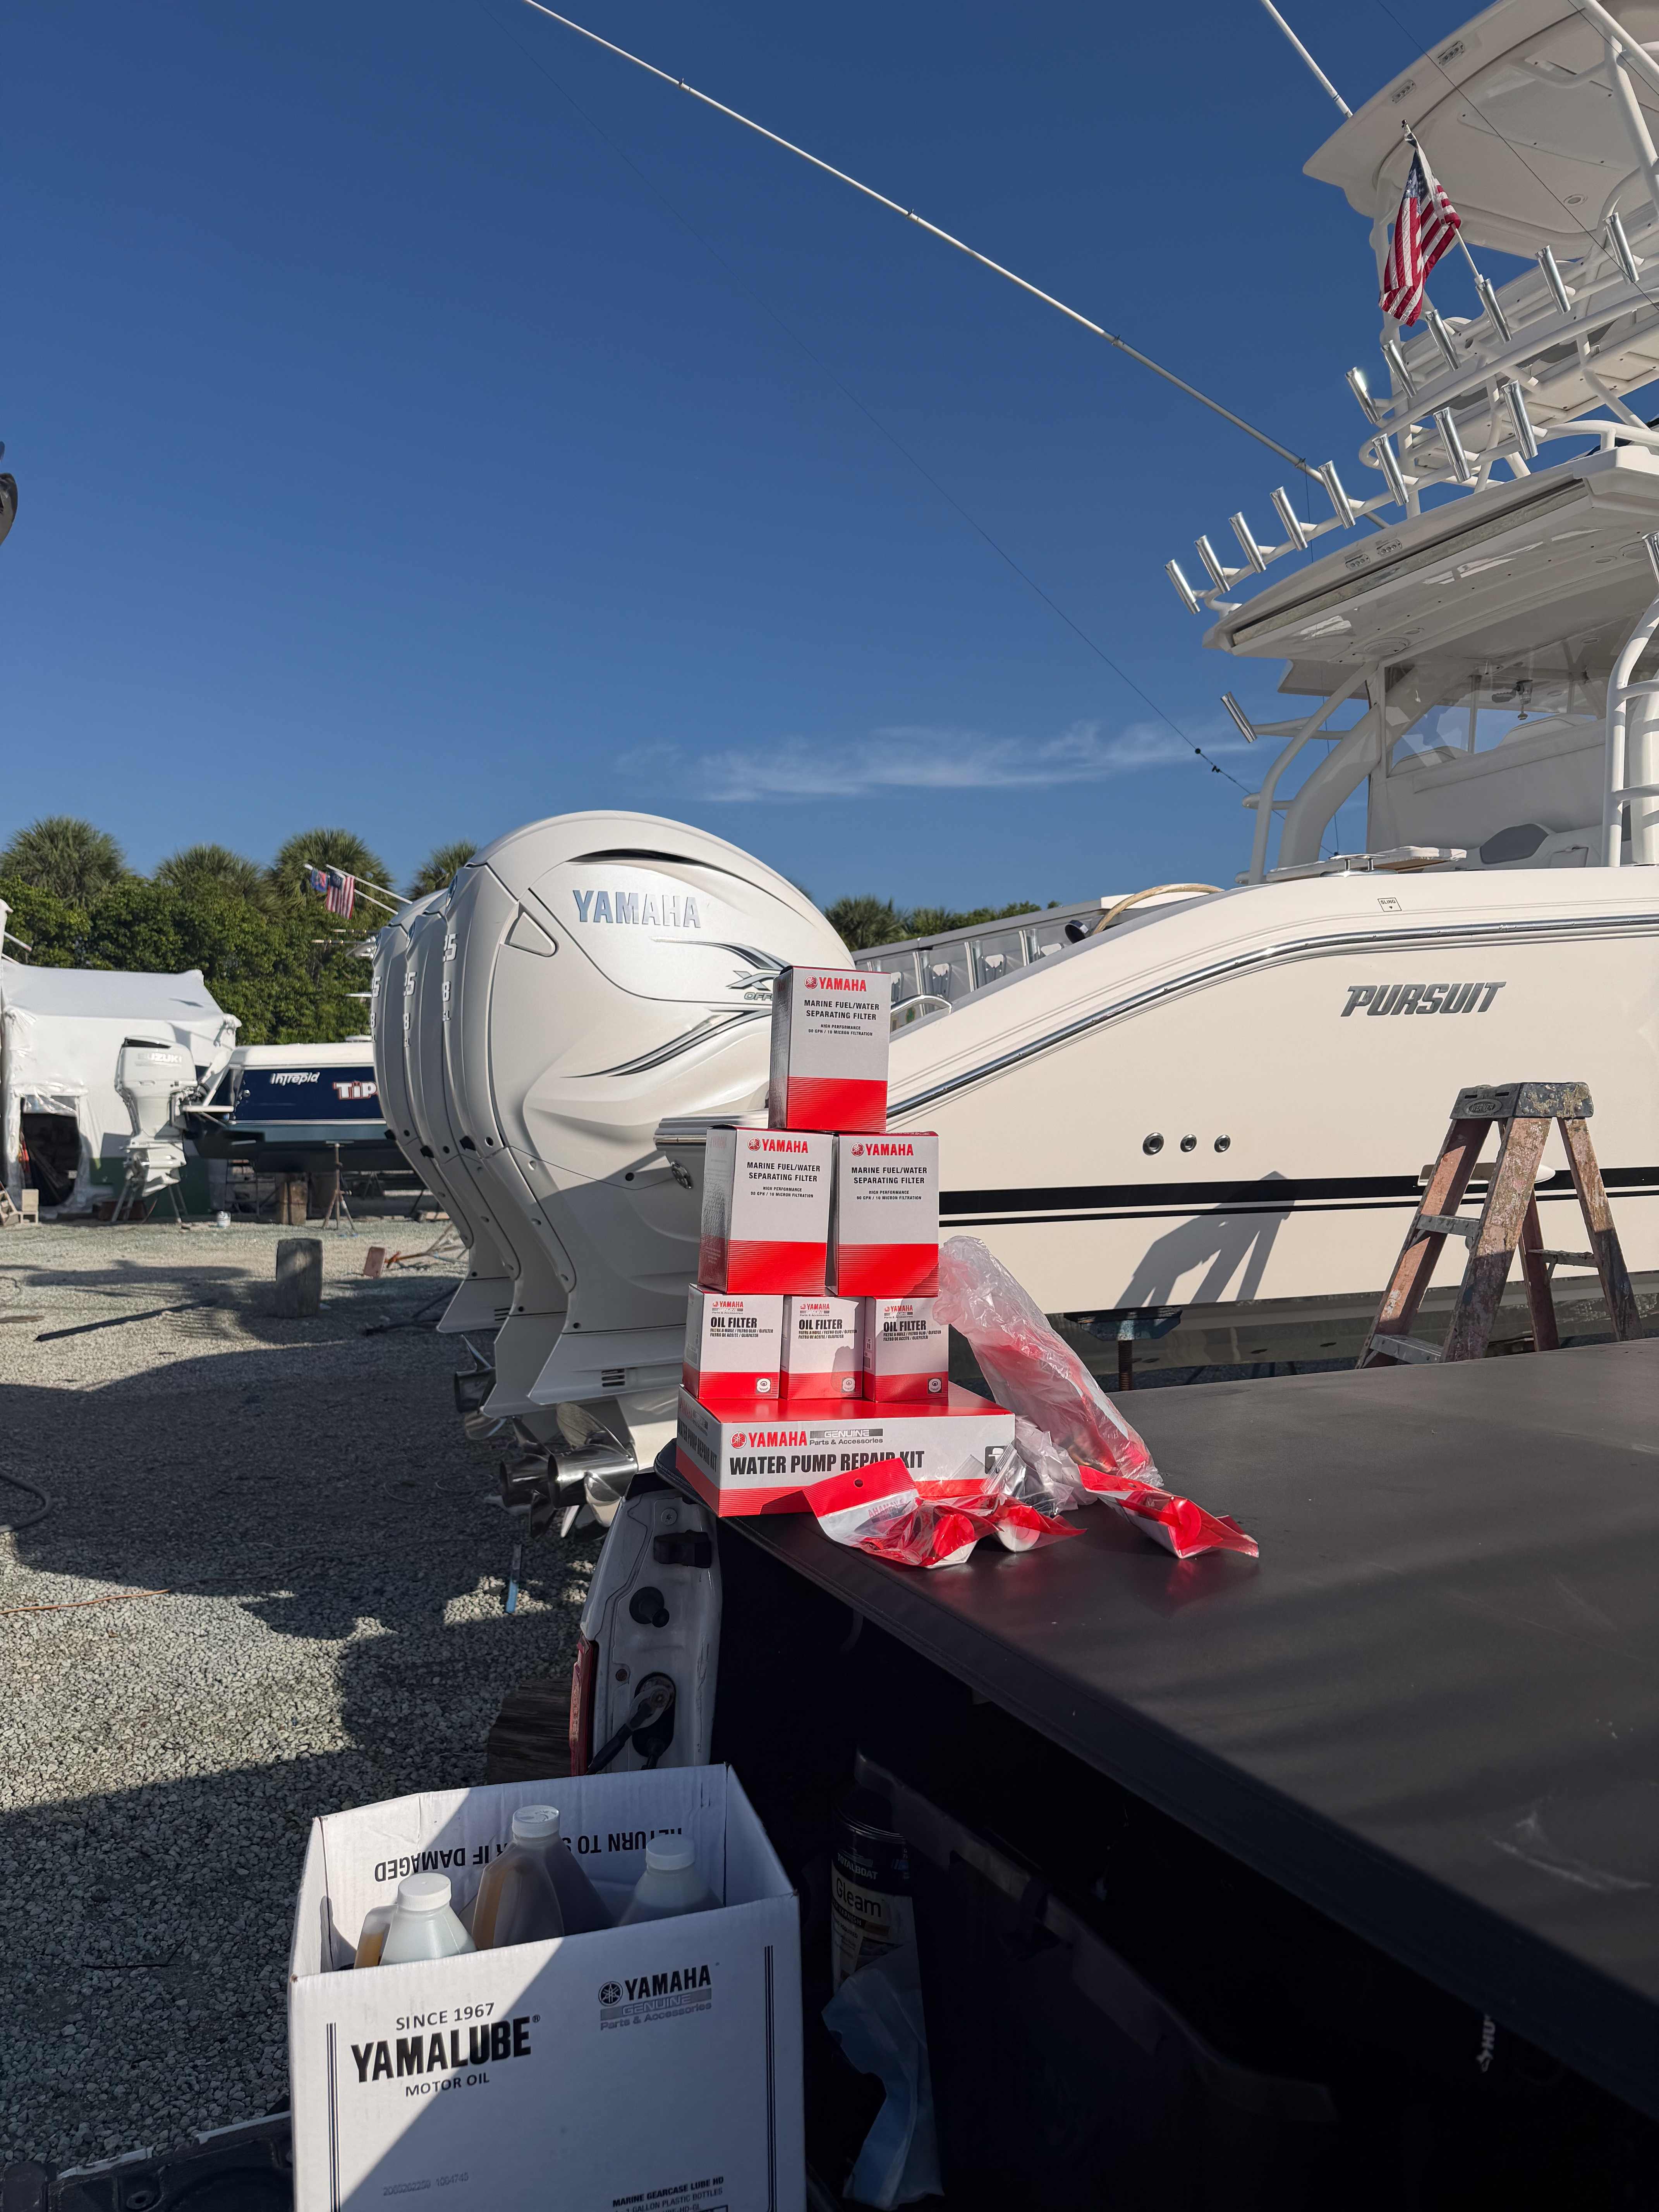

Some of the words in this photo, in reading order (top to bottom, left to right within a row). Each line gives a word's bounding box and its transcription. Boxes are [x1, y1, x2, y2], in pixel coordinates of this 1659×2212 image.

[572, 890, 701, 928] YAMAHA
[819, 977, 867, 992] YAMAHA
[744, 992, 773, 1001] OFF
[835, 1001, 879, 1010] FUEL/WATER
[1341, 981, 1507, 1017] PURSUIT
[806, 1010, 850, 1019] SEPARATING
[762, 1139, 809, 1153] YAMAHA
[865, 1144, 914, 1156] YAMAHA
[749, 1172, 792, 1181] SEPARATING
[778, 1163, 820, 1172] FUEL/WATER
[711, 1317, 725, 1328] OIL
[728, 1317, 757, 1328] FILTER
[799, 1319, 813, 1330] OIL
[815, 1319, 843, 1329] FILTER
[883, 1321, 897, 1332] OIL
[899, 1320, 926, 1331] FILTER
[749, 1431, 807, 1448] YAMAHA
[824, 1429, 869, 1438] GENUINE
[688, 1428, 697, 1451] PUMP
[697, 1437, 710, 1466] REPAIR
[730, 1456, 786, 1475] WATER
[790, 1454, 836, 1473] PUMP
[900, 1451, 925, 1468] KIT
[578, 1835, 602, 1854] TO
[374, 1847, 465, 1882] DAMAGED
[473, 1845, 489, 1865] IF
[836, 1852, 879, 1880] TOTALBOAT
[836, 1877, 881, 1917] Gleam
[624, 1965, 711, 2001] YAMAHA
[623, 1994, 692, 2016] GENUINE
[396, 2010, 448, 2031] SINCE
[454, 2002, 495, 2022] 1967
[600, 2018, 630, 2030] Parts
[633, 2016, 641, 2025] &
[644, 2002, 712, 2022] Accessories
[406, 2077, 462, 2097] MOTOR
[467, 2073, 490, 2086] OIL
[613, 2193, 644, 2207] MARINE
[647, 2184, 688, 2200] GEARCASE
[691, 2179, 710, 2190] LUBE
[713, 2176, 724, 2185] HD
[632, 2201, 660, 2212] GALLON
[662, 2194, 690, 2207] PLASTIC
[693, 2187, 723, 2201] BOTTLES
